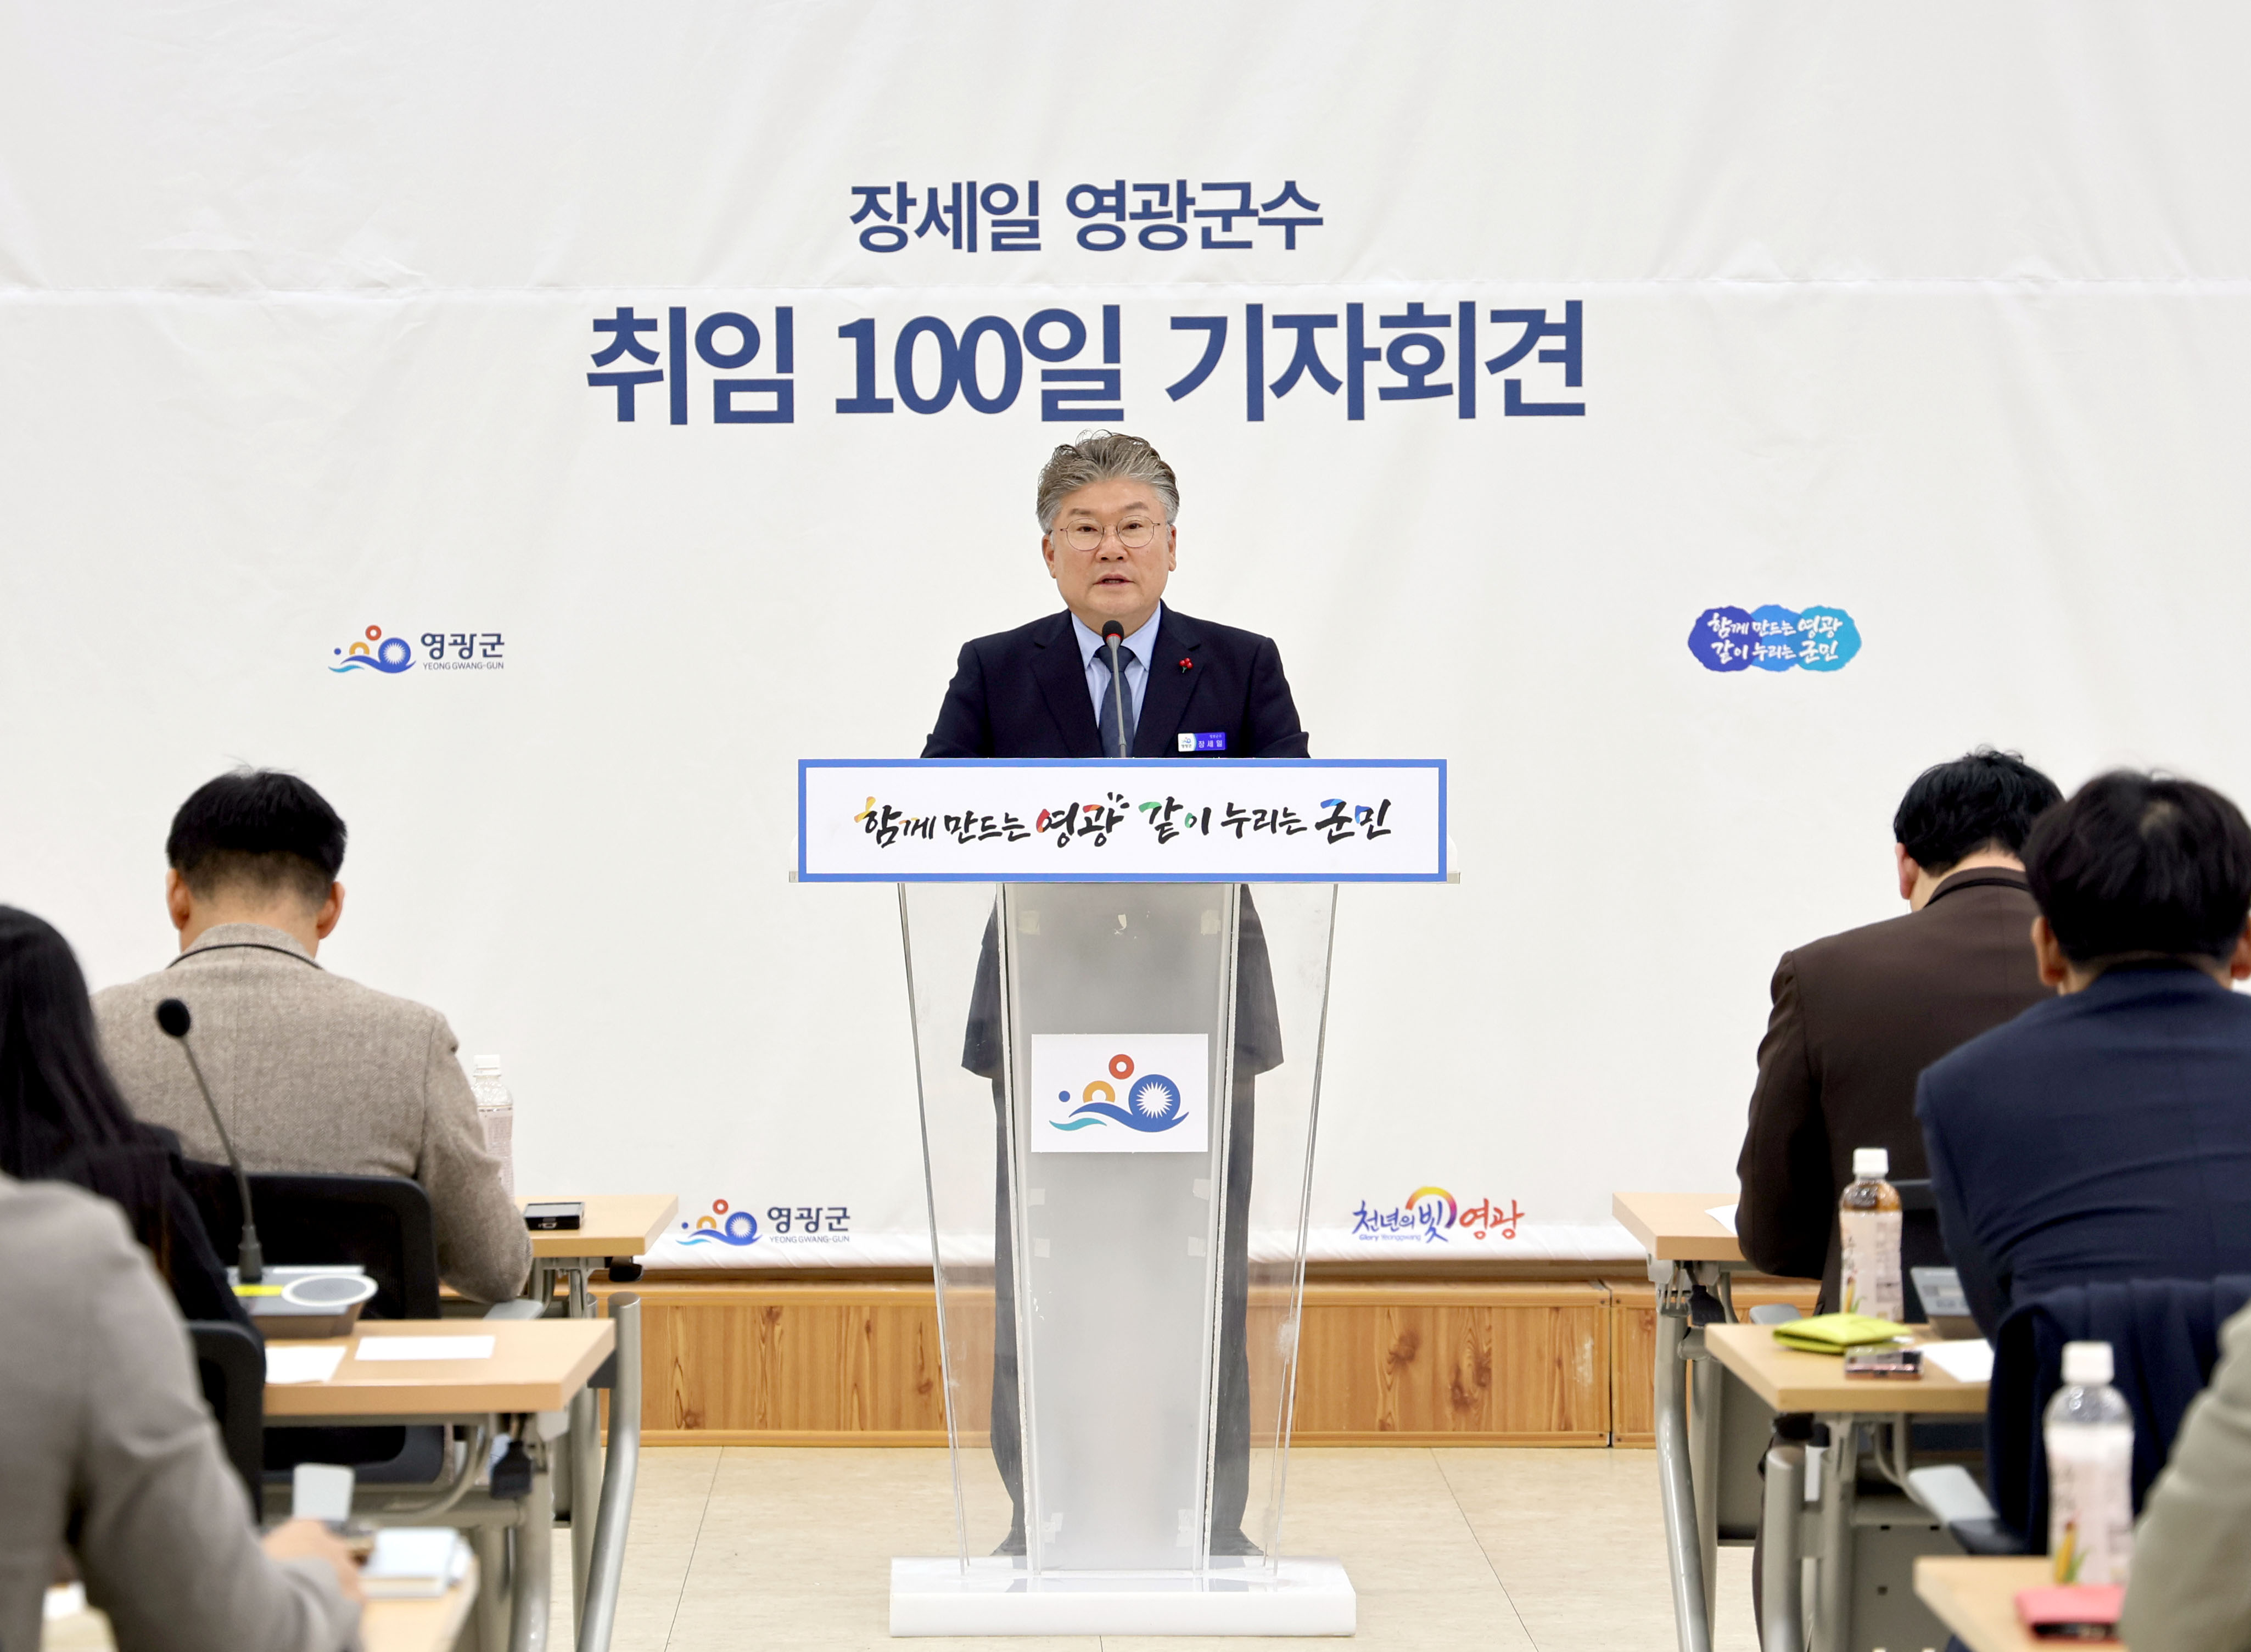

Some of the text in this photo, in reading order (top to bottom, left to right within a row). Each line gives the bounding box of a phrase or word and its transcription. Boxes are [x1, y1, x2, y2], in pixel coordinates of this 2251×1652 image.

[849, 180, 1323, 253] 장세일 영광군수
[587, 300, 1586, 426] 취임 100일 기자회견
[1707, 612, 1843, 639] 함께 만드는 영광
[421, 632, 505, 660] 영광군
[1711, 639, 1839, 664] 같이 누리는 군민
[452, 662, 504, 670] GWANG-GUN
[854, 796, 1392, 849] 함께 만드는 영광 같이 누리는 군민
[767, 1207, 850, 1234] 영광군
[1352, 1198, 1525, 1244] 천년의 빛 영광
[798, 1235, 850, 1244] GWANG-GUN
